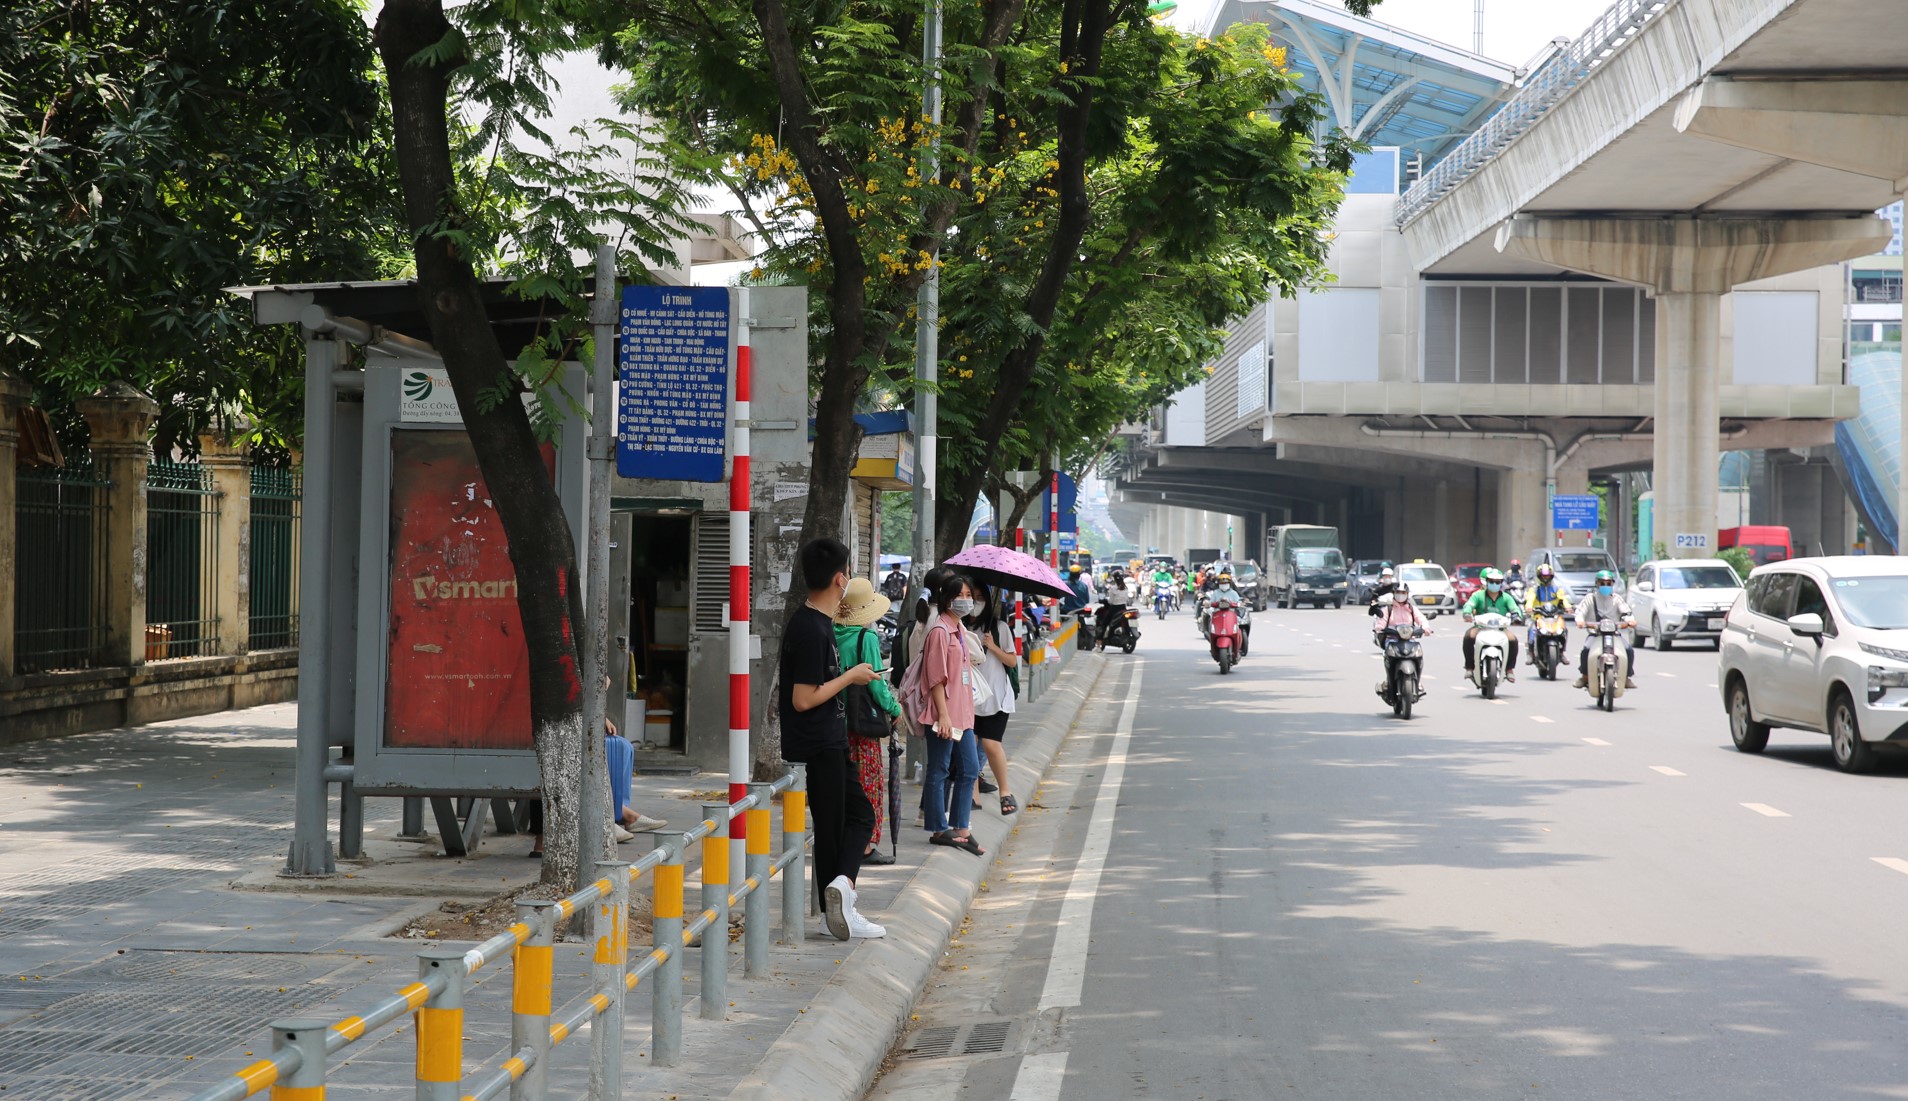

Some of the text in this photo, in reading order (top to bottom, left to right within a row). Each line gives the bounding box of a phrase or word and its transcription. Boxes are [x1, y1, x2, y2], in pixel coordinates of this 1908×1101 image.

[662, 293, 692, 307] LỘ TRÌNH
[402, 401, 428, 409] TỔNG
[1678, 536, 1705, 546] P212
